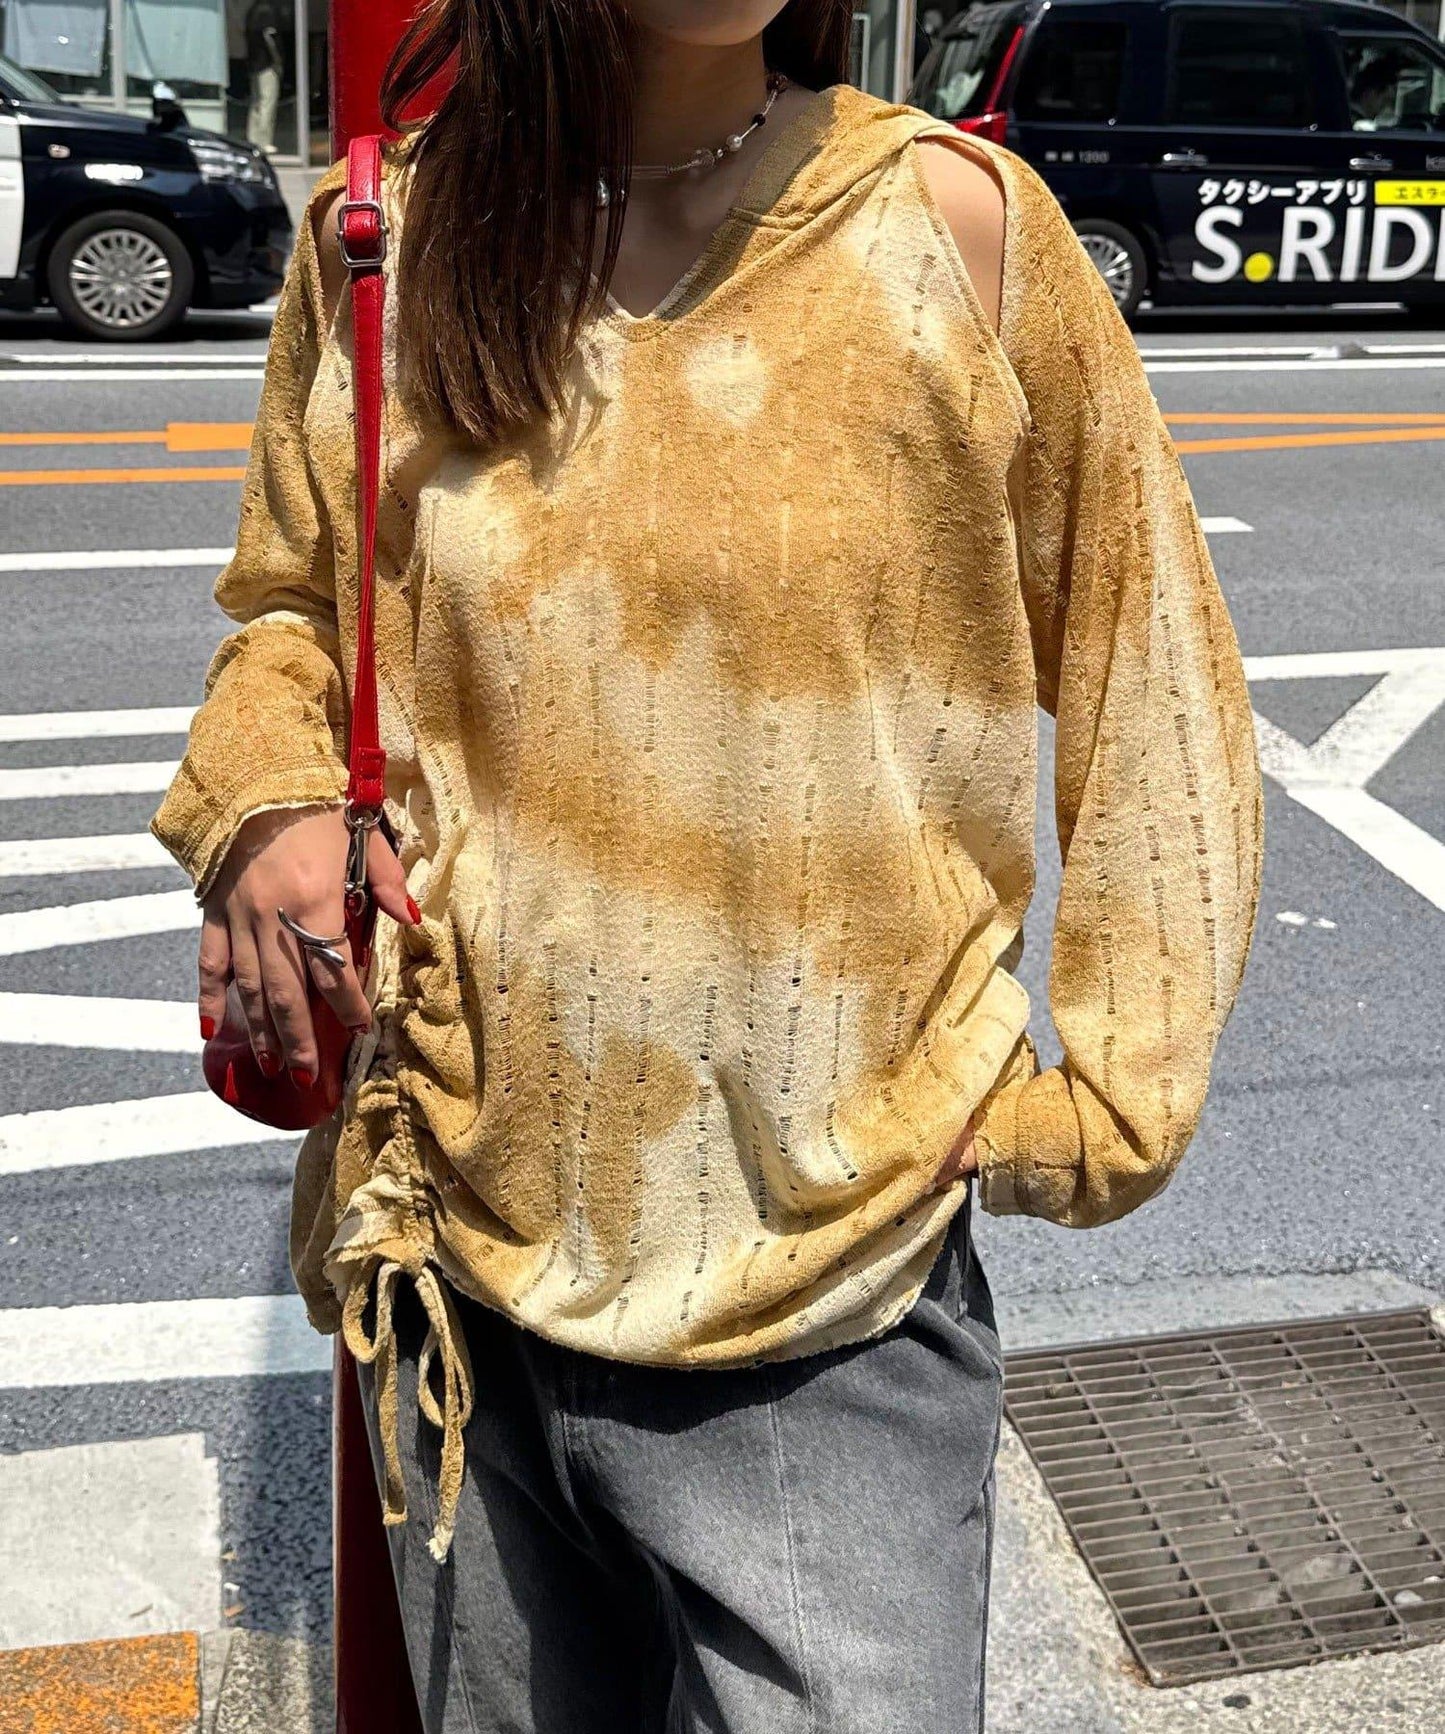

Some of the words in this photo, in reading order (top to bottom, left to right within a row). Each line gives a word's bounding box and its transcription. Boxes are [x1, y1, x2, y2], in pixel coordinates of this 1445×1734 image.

[1198, 178, 1367, 205] タクシーアプリ
